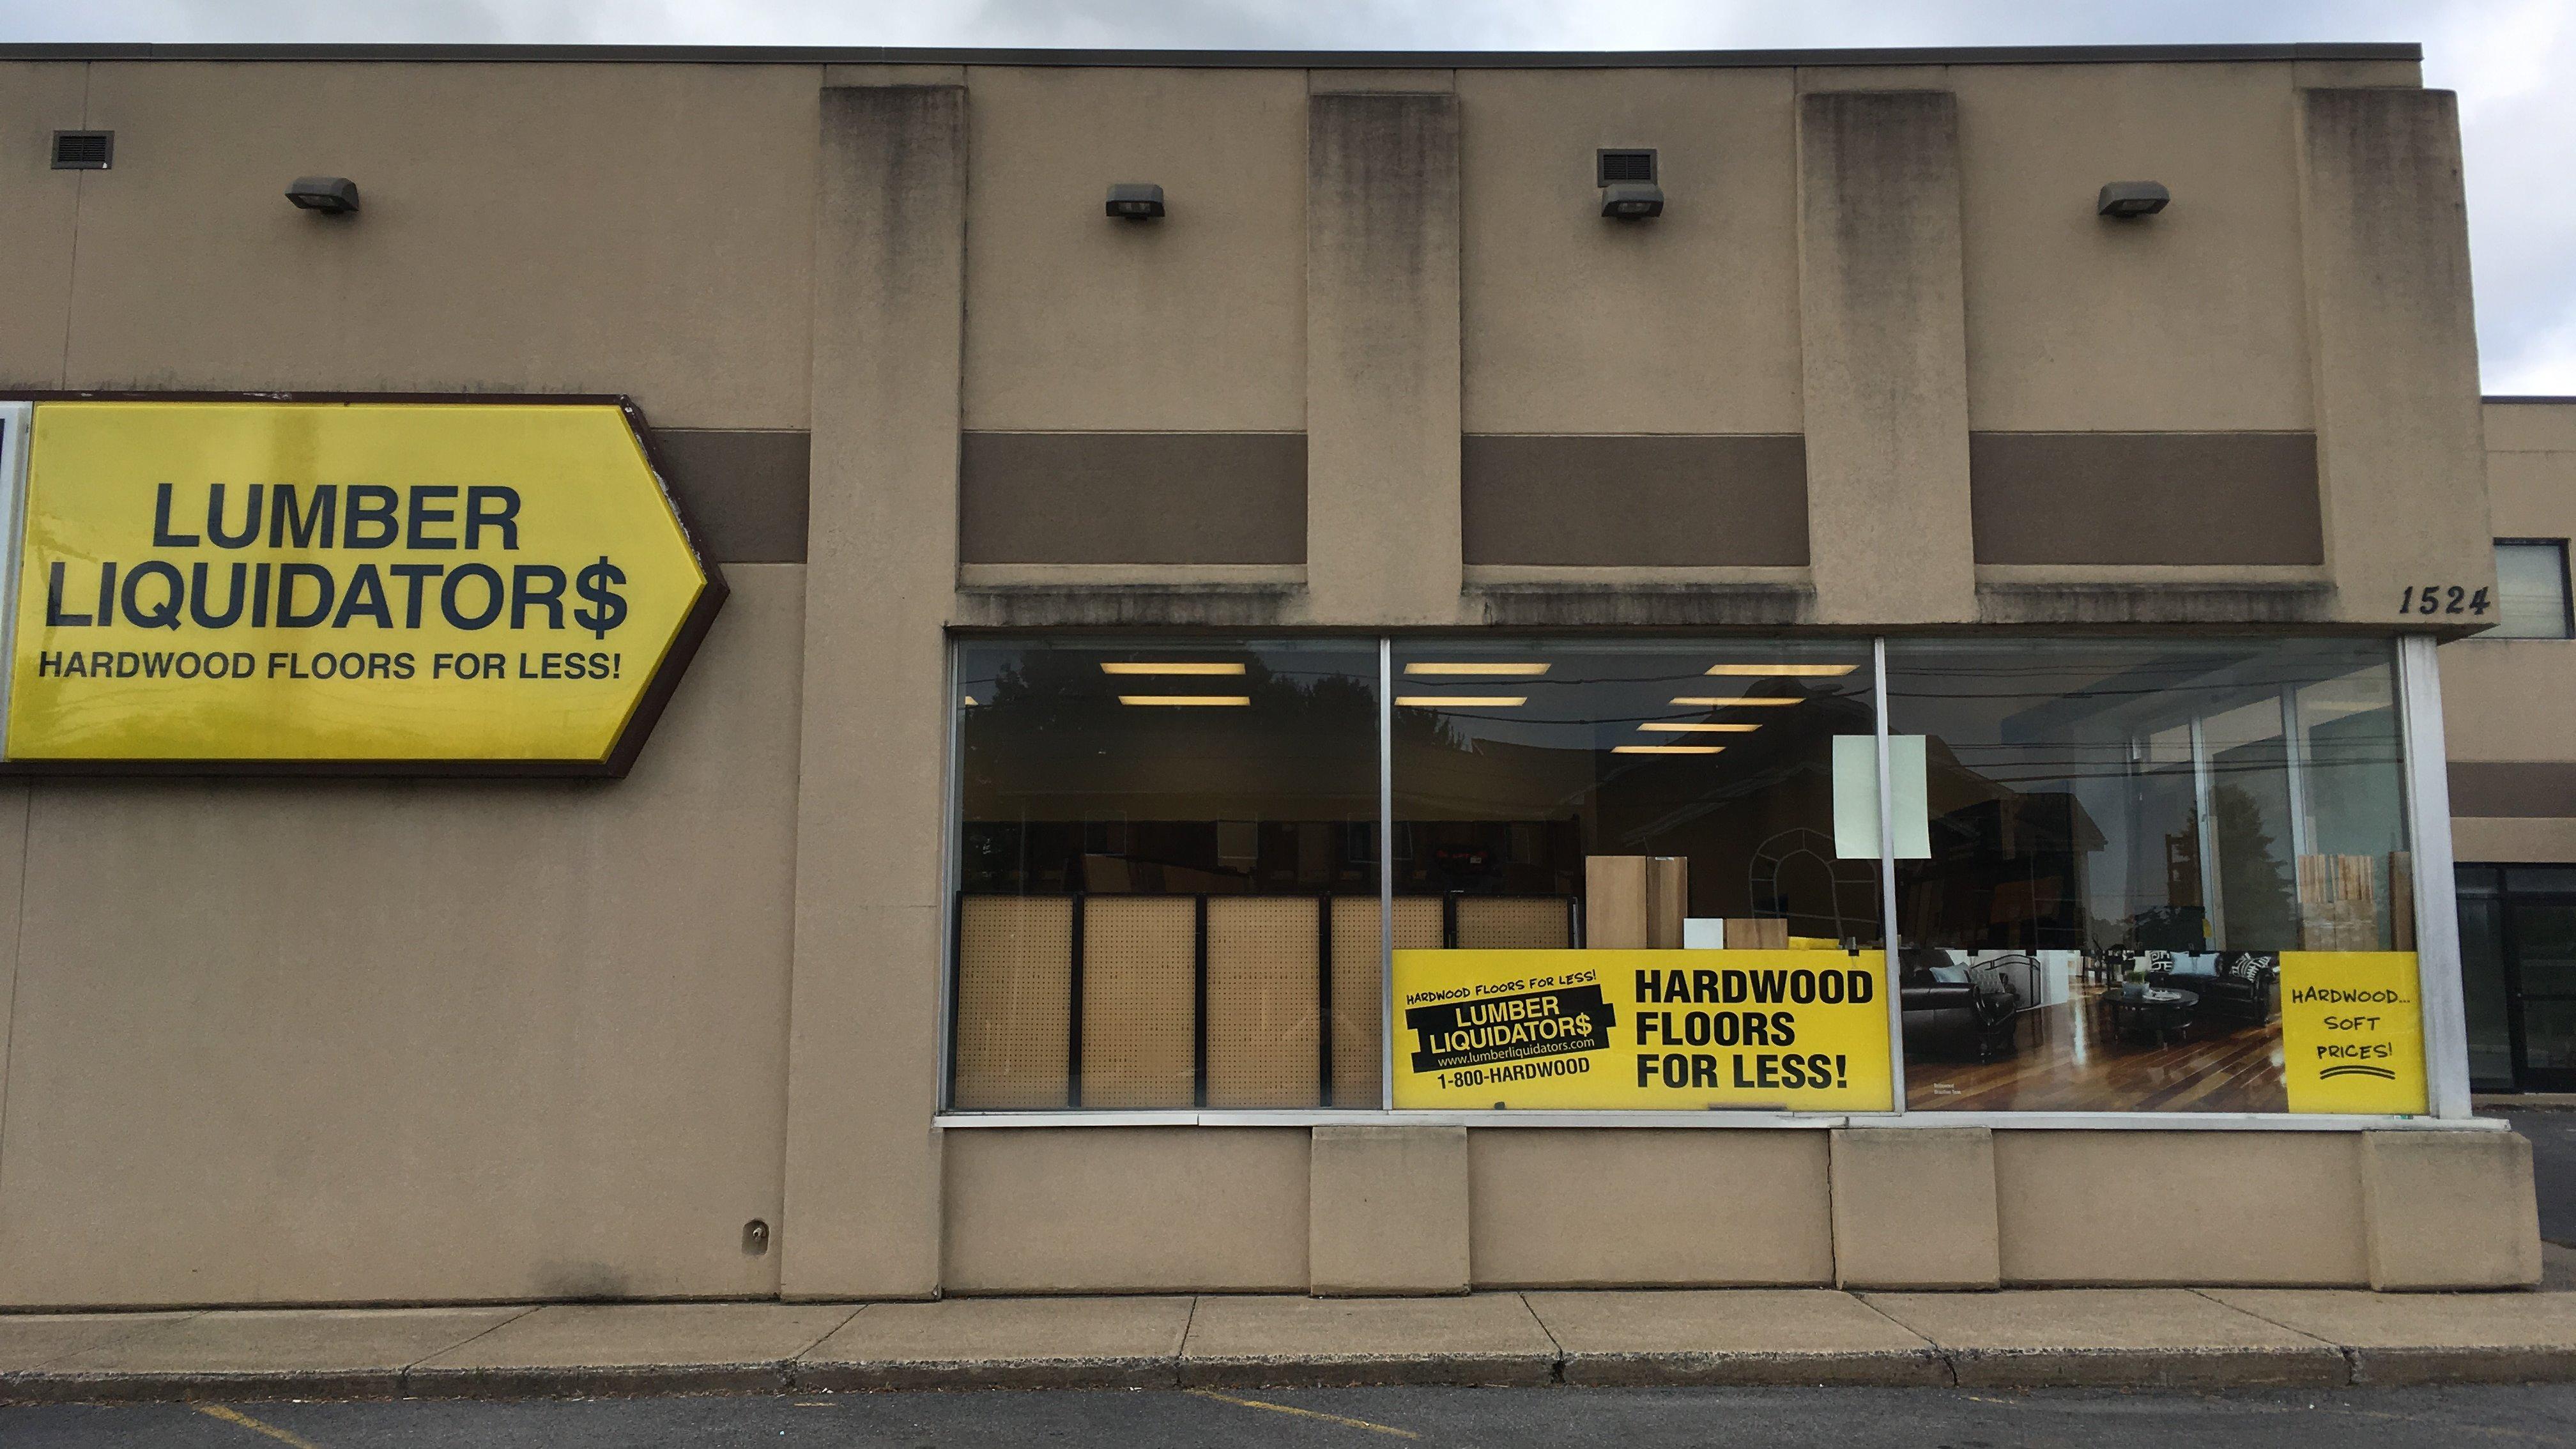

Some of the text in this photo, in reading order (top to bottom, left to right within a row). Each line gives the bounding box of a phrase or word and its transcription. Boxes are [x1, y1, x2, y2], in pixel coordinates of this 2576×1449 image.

[153, 483, 521, 550] LUMBER
[45, 556, 627, 640] LIQUIDATOR$
[2399, 585, 2491, 615] 1524
[39, 651, 621, 679] HARDWOOD FLOORS FOR LESS!
[1406, 969, 1597, 1005] HARDWOOD FLOORS FOR LESS!
[1636, 969, 1873, 1004] HARDWOOD
[2292, 986, 2411, 1004] HARDWOOD...
[1455, 995, 1560, 1027] LUMBER
[2324, 1016, 2380, 1031] SOFT
[1430, 1012, 1593, 1054] LIQUIDATOR$
[1636, 1011, 1795, 1046] FLOORS
[1438, 1038, 1595, 1067] www.lumberliquidators.com
[2317, 1041, 2392, 1059] PRICES!
[1438, 1057, 1590, 1089] 1-800-HARDWOOD
[1637, 1053, 1848, 1089] FOR LESS!
